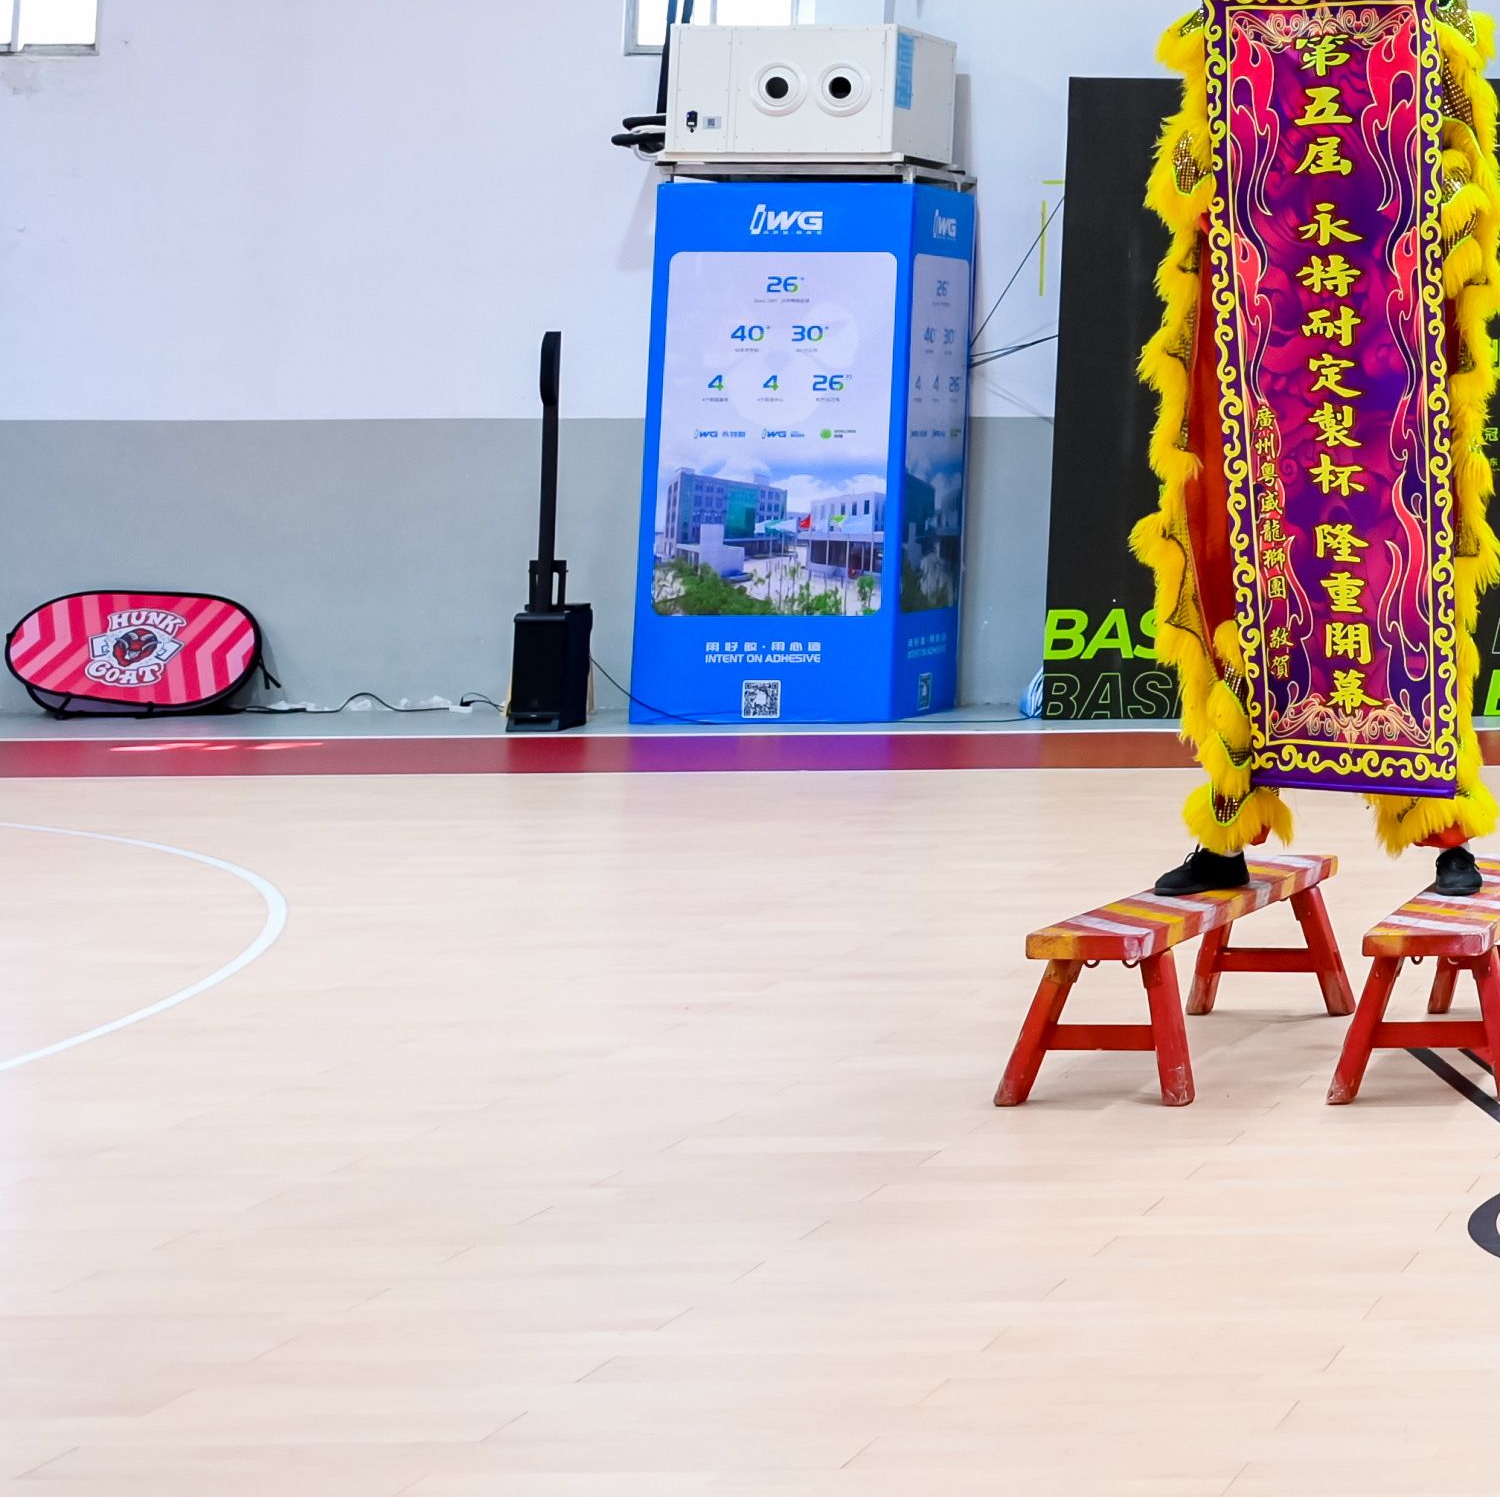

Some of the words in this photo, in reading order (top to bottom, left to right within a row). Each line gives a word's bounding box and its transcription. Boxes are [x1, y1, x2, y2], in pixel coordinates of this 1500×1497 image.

[707, 374, 724, 391] 4
[762, 374, 779, 391] 4
[110, 611, 183, 633] HUNK
[705, 653, 743, 664] INTENT
[746, 653, 763, 664] ON
[765, 653, 822, 664] ADHESIVE
[88, 660, 162, 684] GOAT
